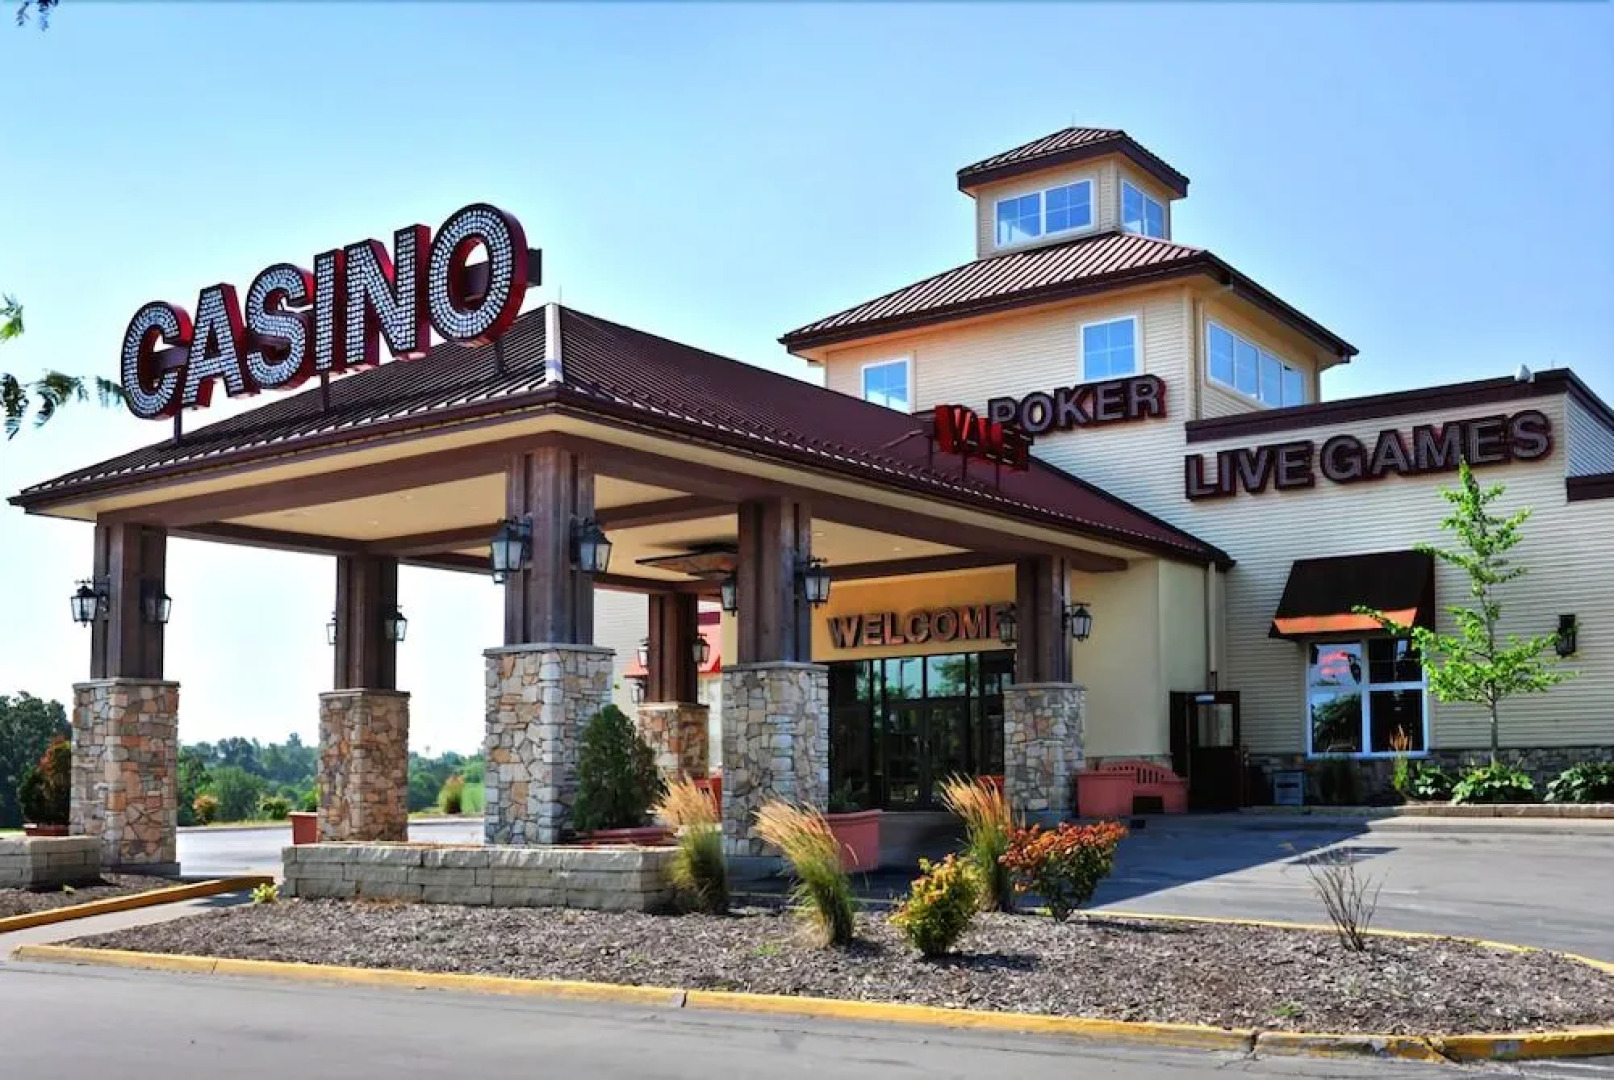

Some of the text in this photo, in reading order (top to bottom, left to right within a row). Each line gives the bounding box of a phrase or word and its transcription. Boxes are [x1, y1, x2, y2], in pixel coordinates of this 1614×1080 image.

[121, 203, 528, 420] CASINO
[987, 373, 1167, 435] POKER
[1185, 409, 1553, 501] LIVE GAMES
